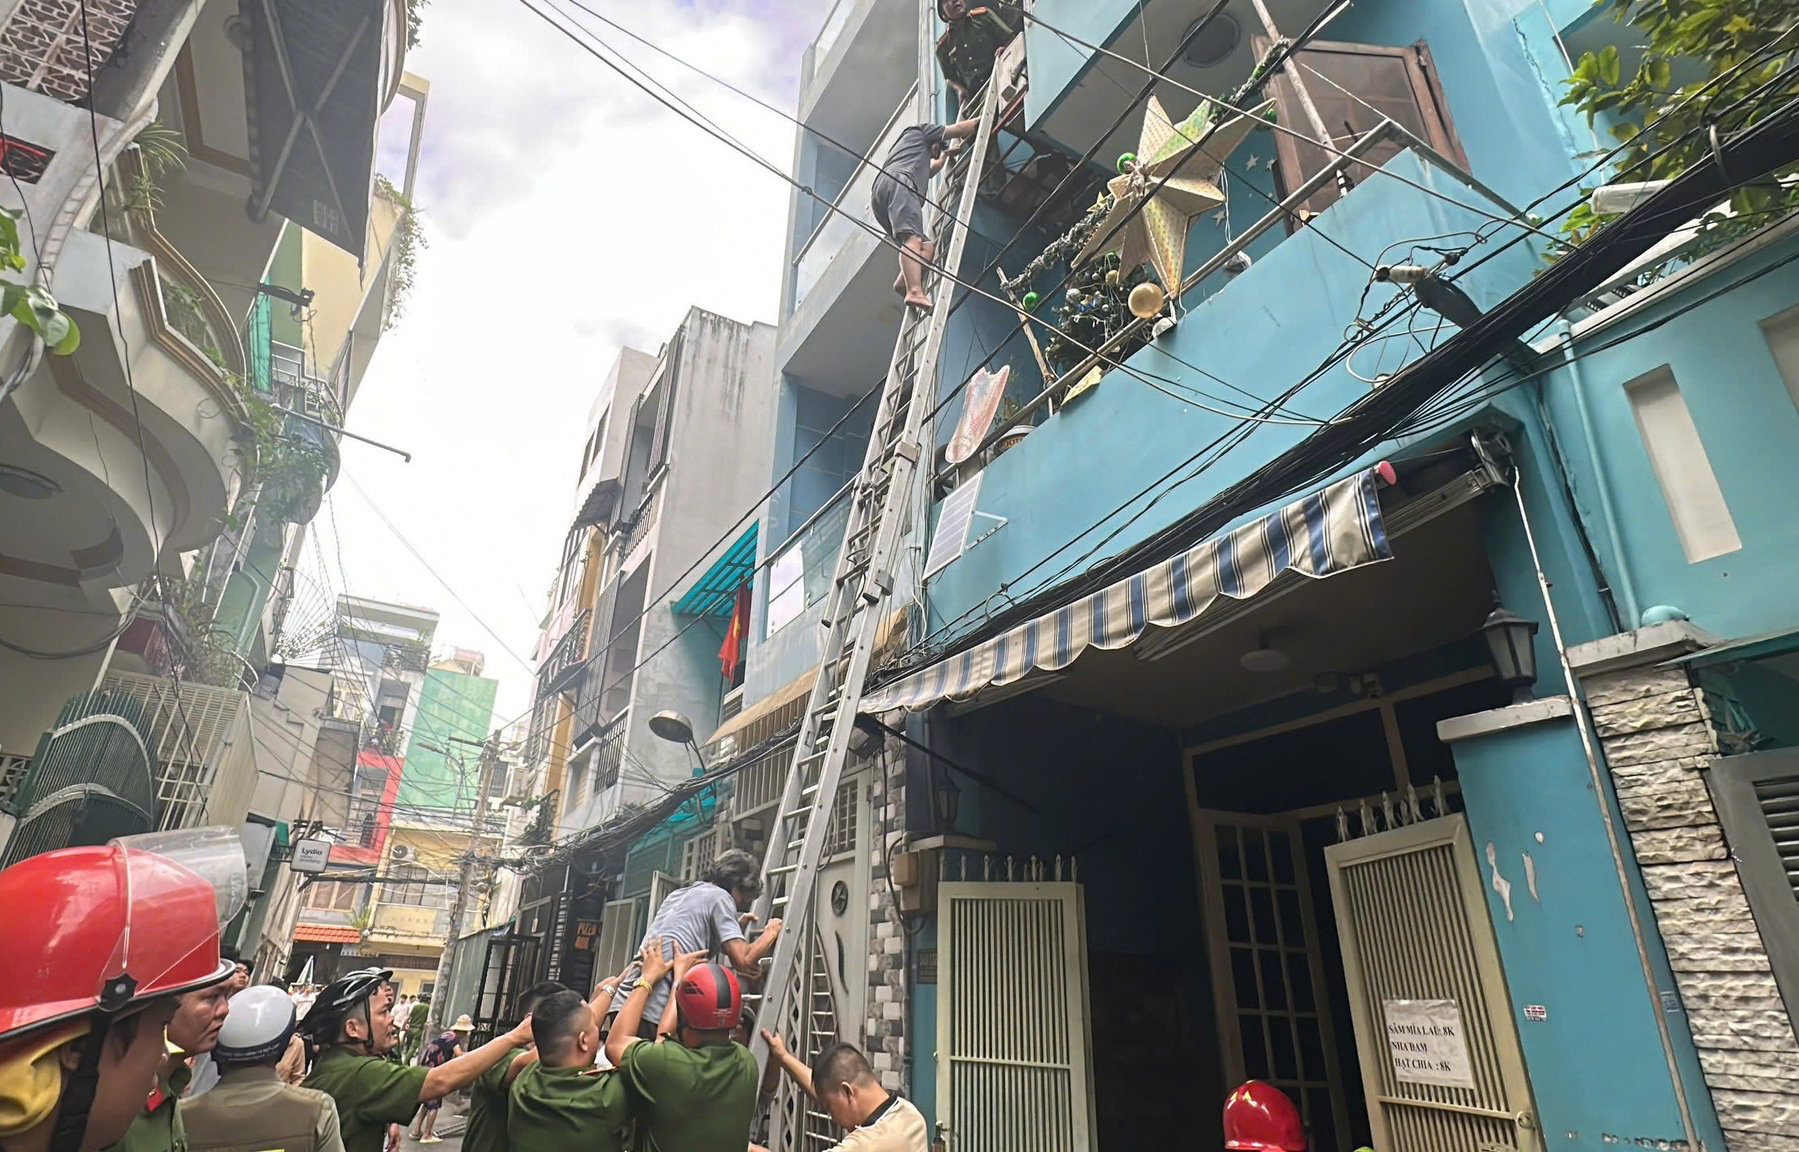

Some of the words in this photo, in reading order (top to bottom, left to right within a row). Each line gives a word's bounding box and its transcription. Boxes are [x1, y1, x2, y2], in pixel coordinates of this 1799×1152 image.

[301, 847, 323, 856] Lydia
[1443, 1026, 1454, 1036] 8K
[1412, 1059, 1432, 1070] CHIA
